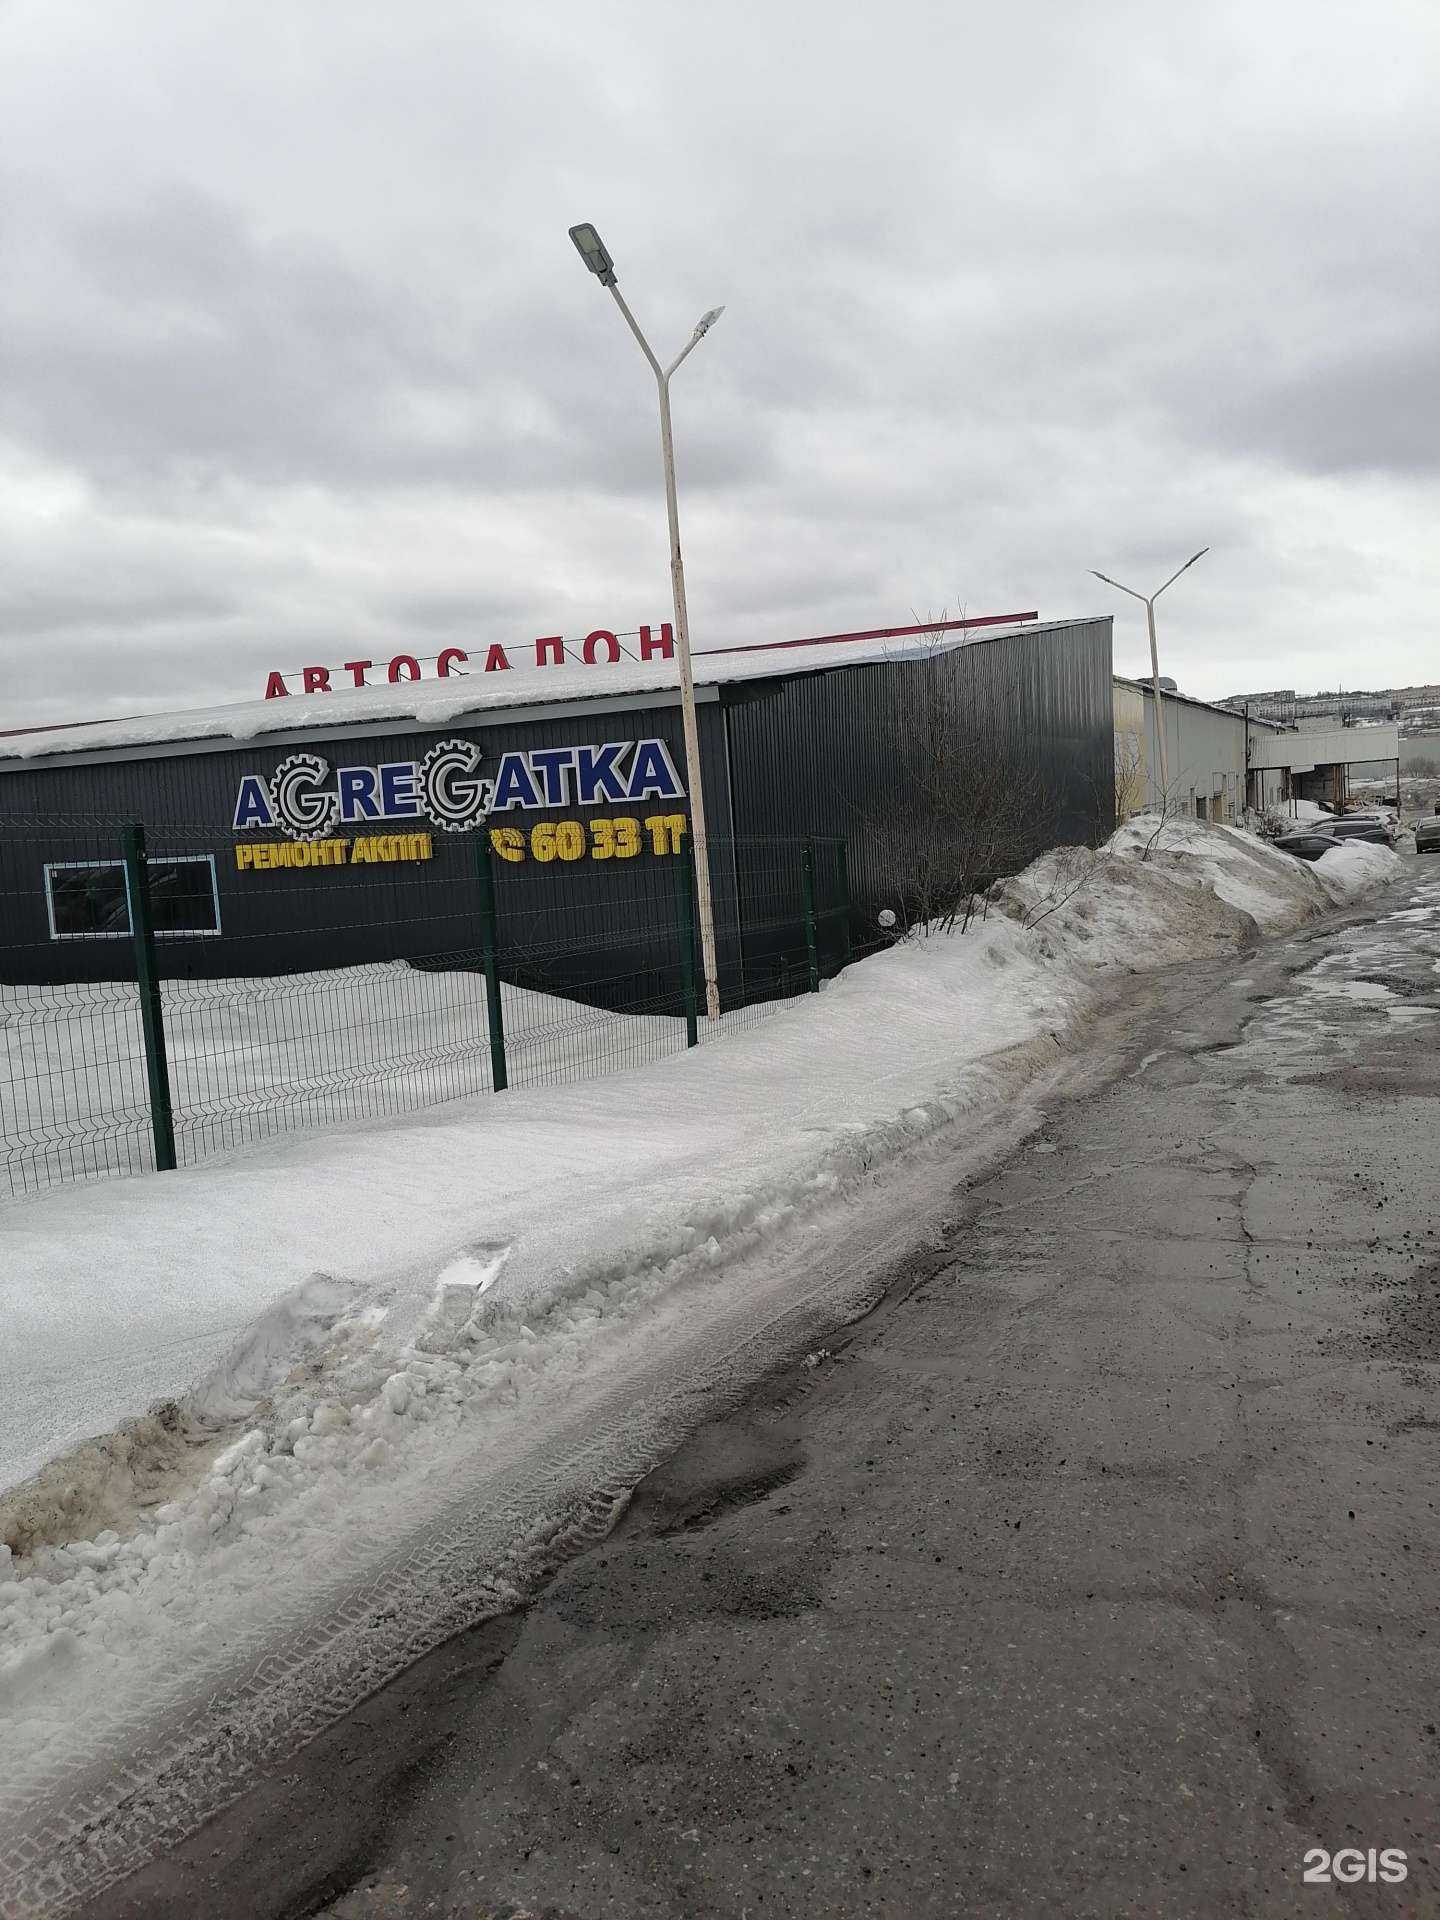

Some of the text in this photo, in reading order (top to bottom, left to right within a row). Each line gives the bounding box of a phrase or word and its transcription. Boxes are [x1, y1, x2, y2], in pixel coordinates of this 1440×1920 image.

[265, 623, 674, 700] АВТОСАЛОН
[232, 738, 688, 841] AGREGATKA
[235, 833, 433, 870] РЕМОНТ АКПП
[531, 820, 585, 862] 60
[590, 817, 642, 859] 33
